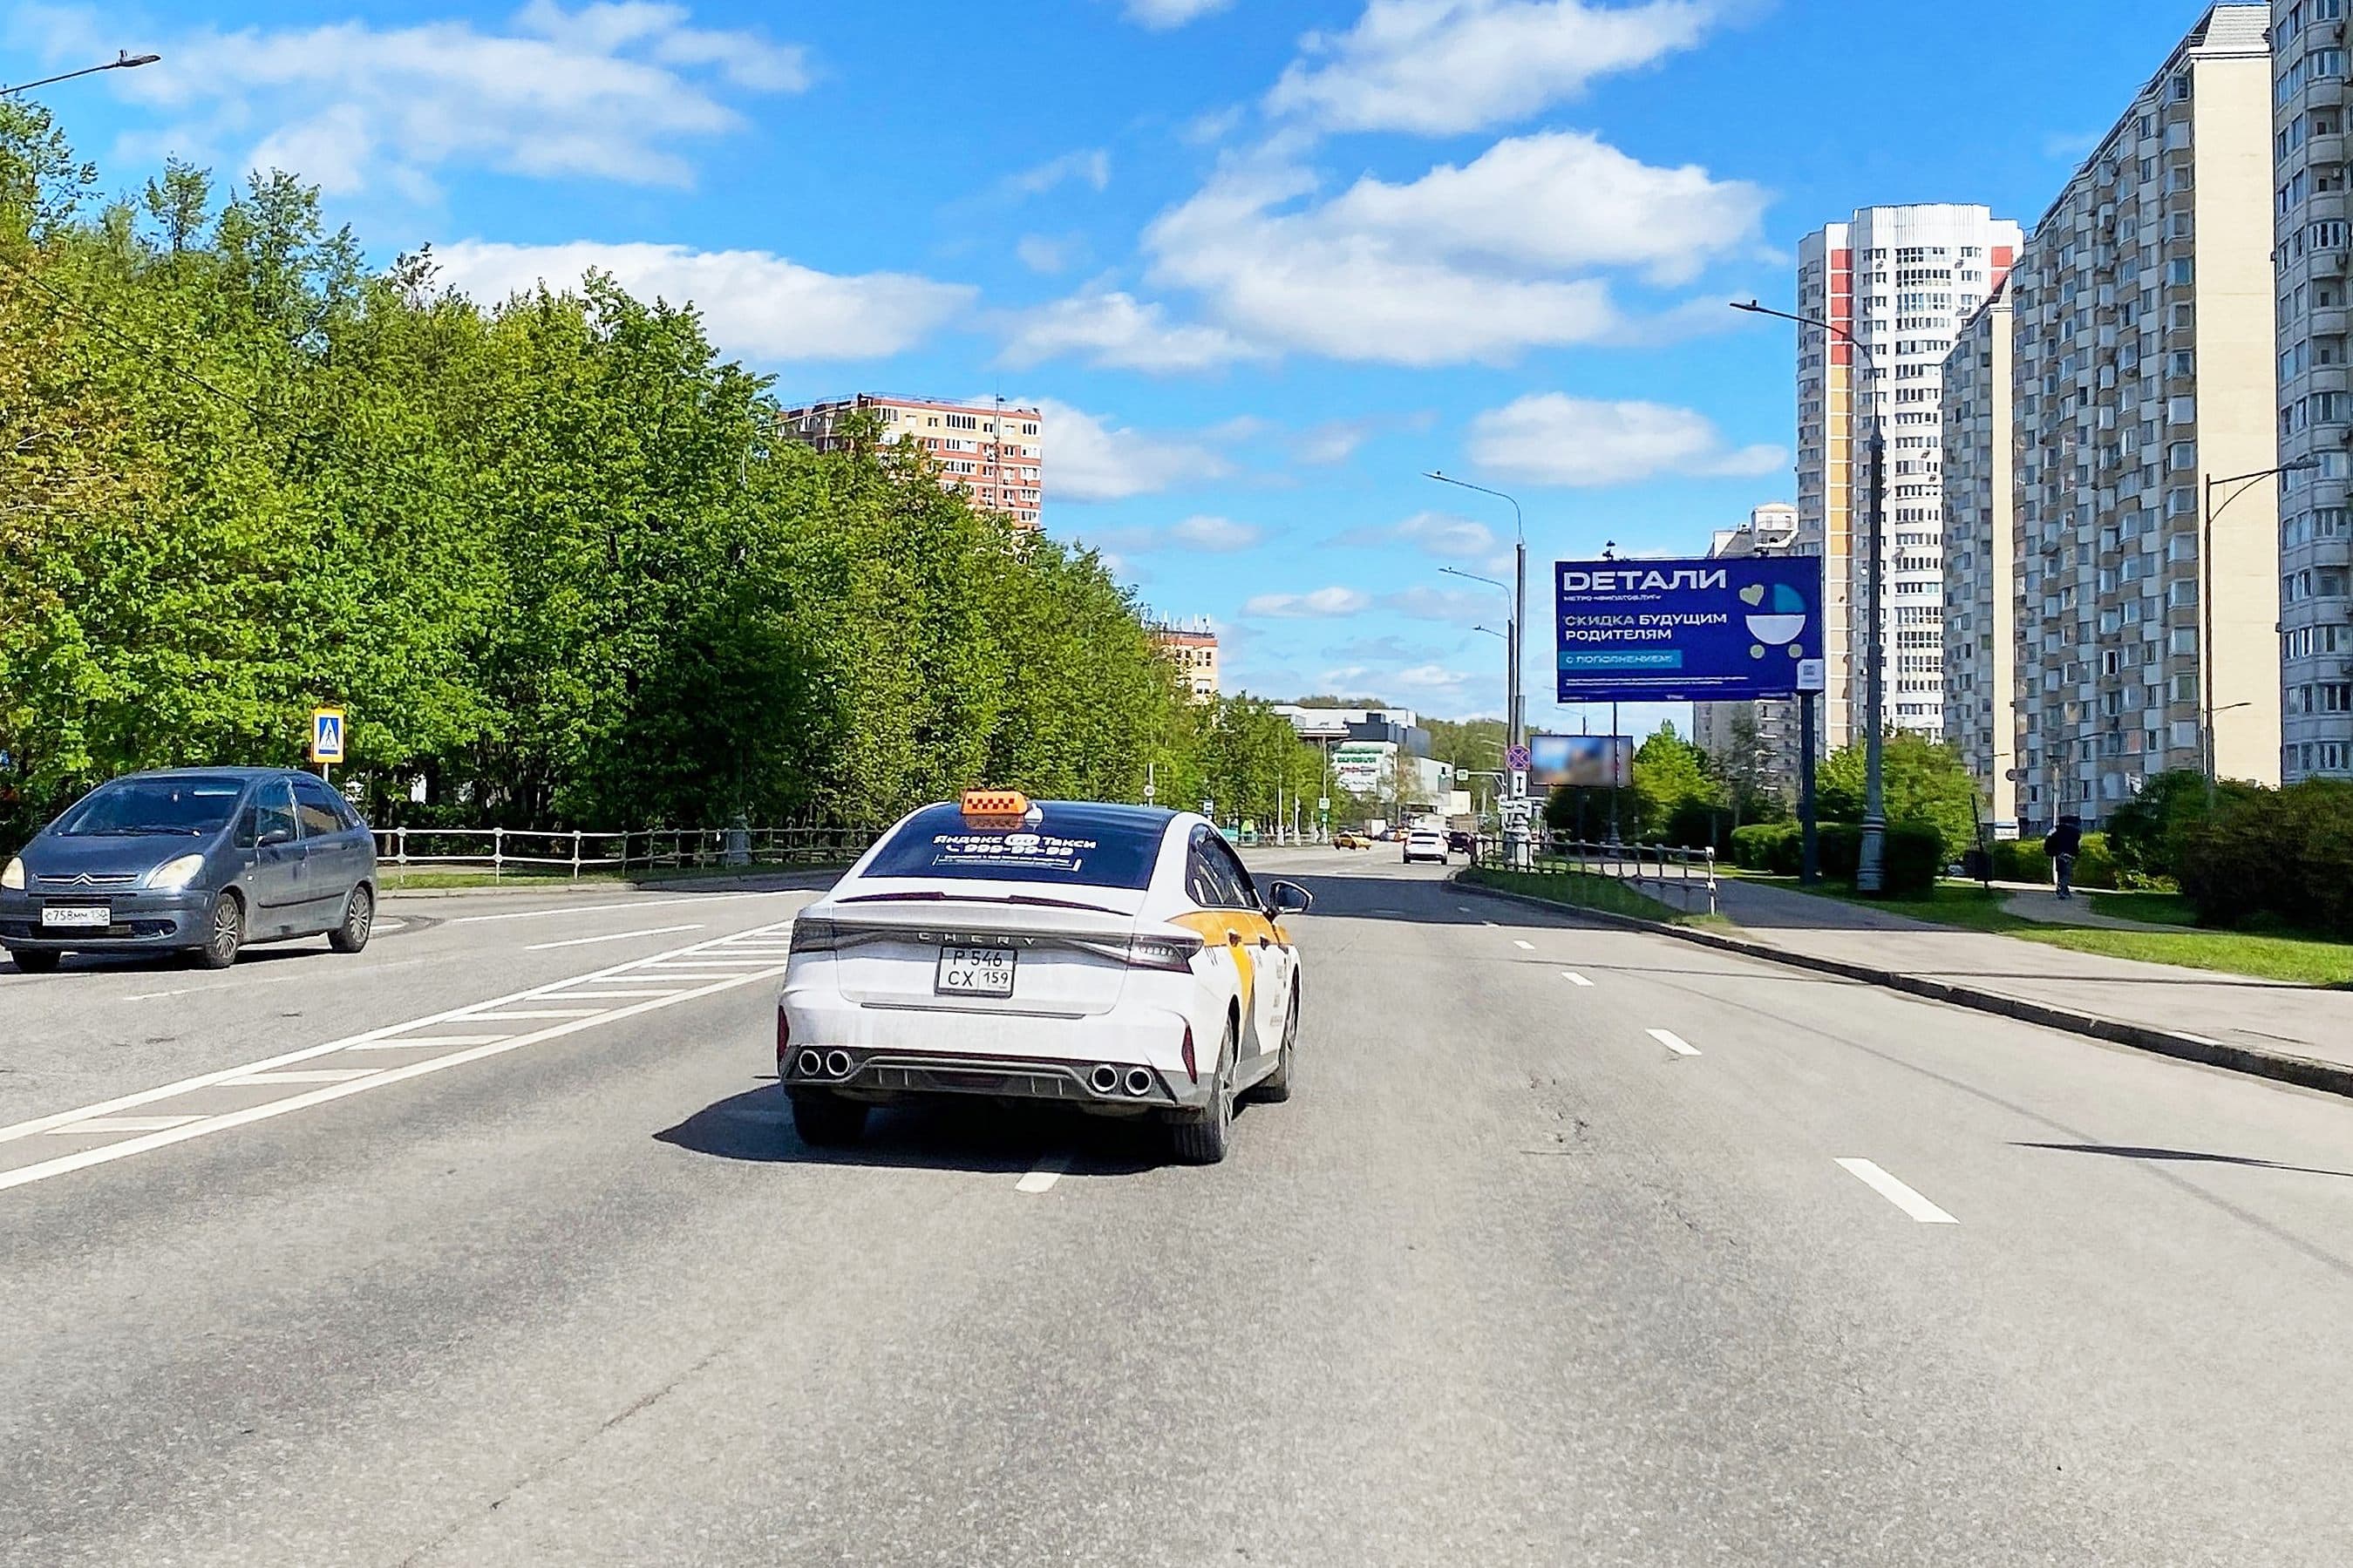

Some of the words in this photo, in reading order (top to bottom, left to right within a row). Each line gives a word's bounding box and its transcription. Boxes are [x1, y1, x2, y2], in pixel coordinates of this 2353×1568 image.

[1565, 615, 1636, 628] СКИДКА
[1639, 614, 1728, 626] БУДУЩИМ
[1566, 629, 1672, 641] РОДИТЕЛЯМ
[933, 835, 1003, 845] Яндекс
[1042, 836, 1097, 849] Такси
[918, 932, 1036, 946] CHERY
[953, 950, 965, 966] Р
[970, 950, 1003, 967] 546
[948, 970, 974, 987] СХ
[983, 972, 1009, 985] 159
